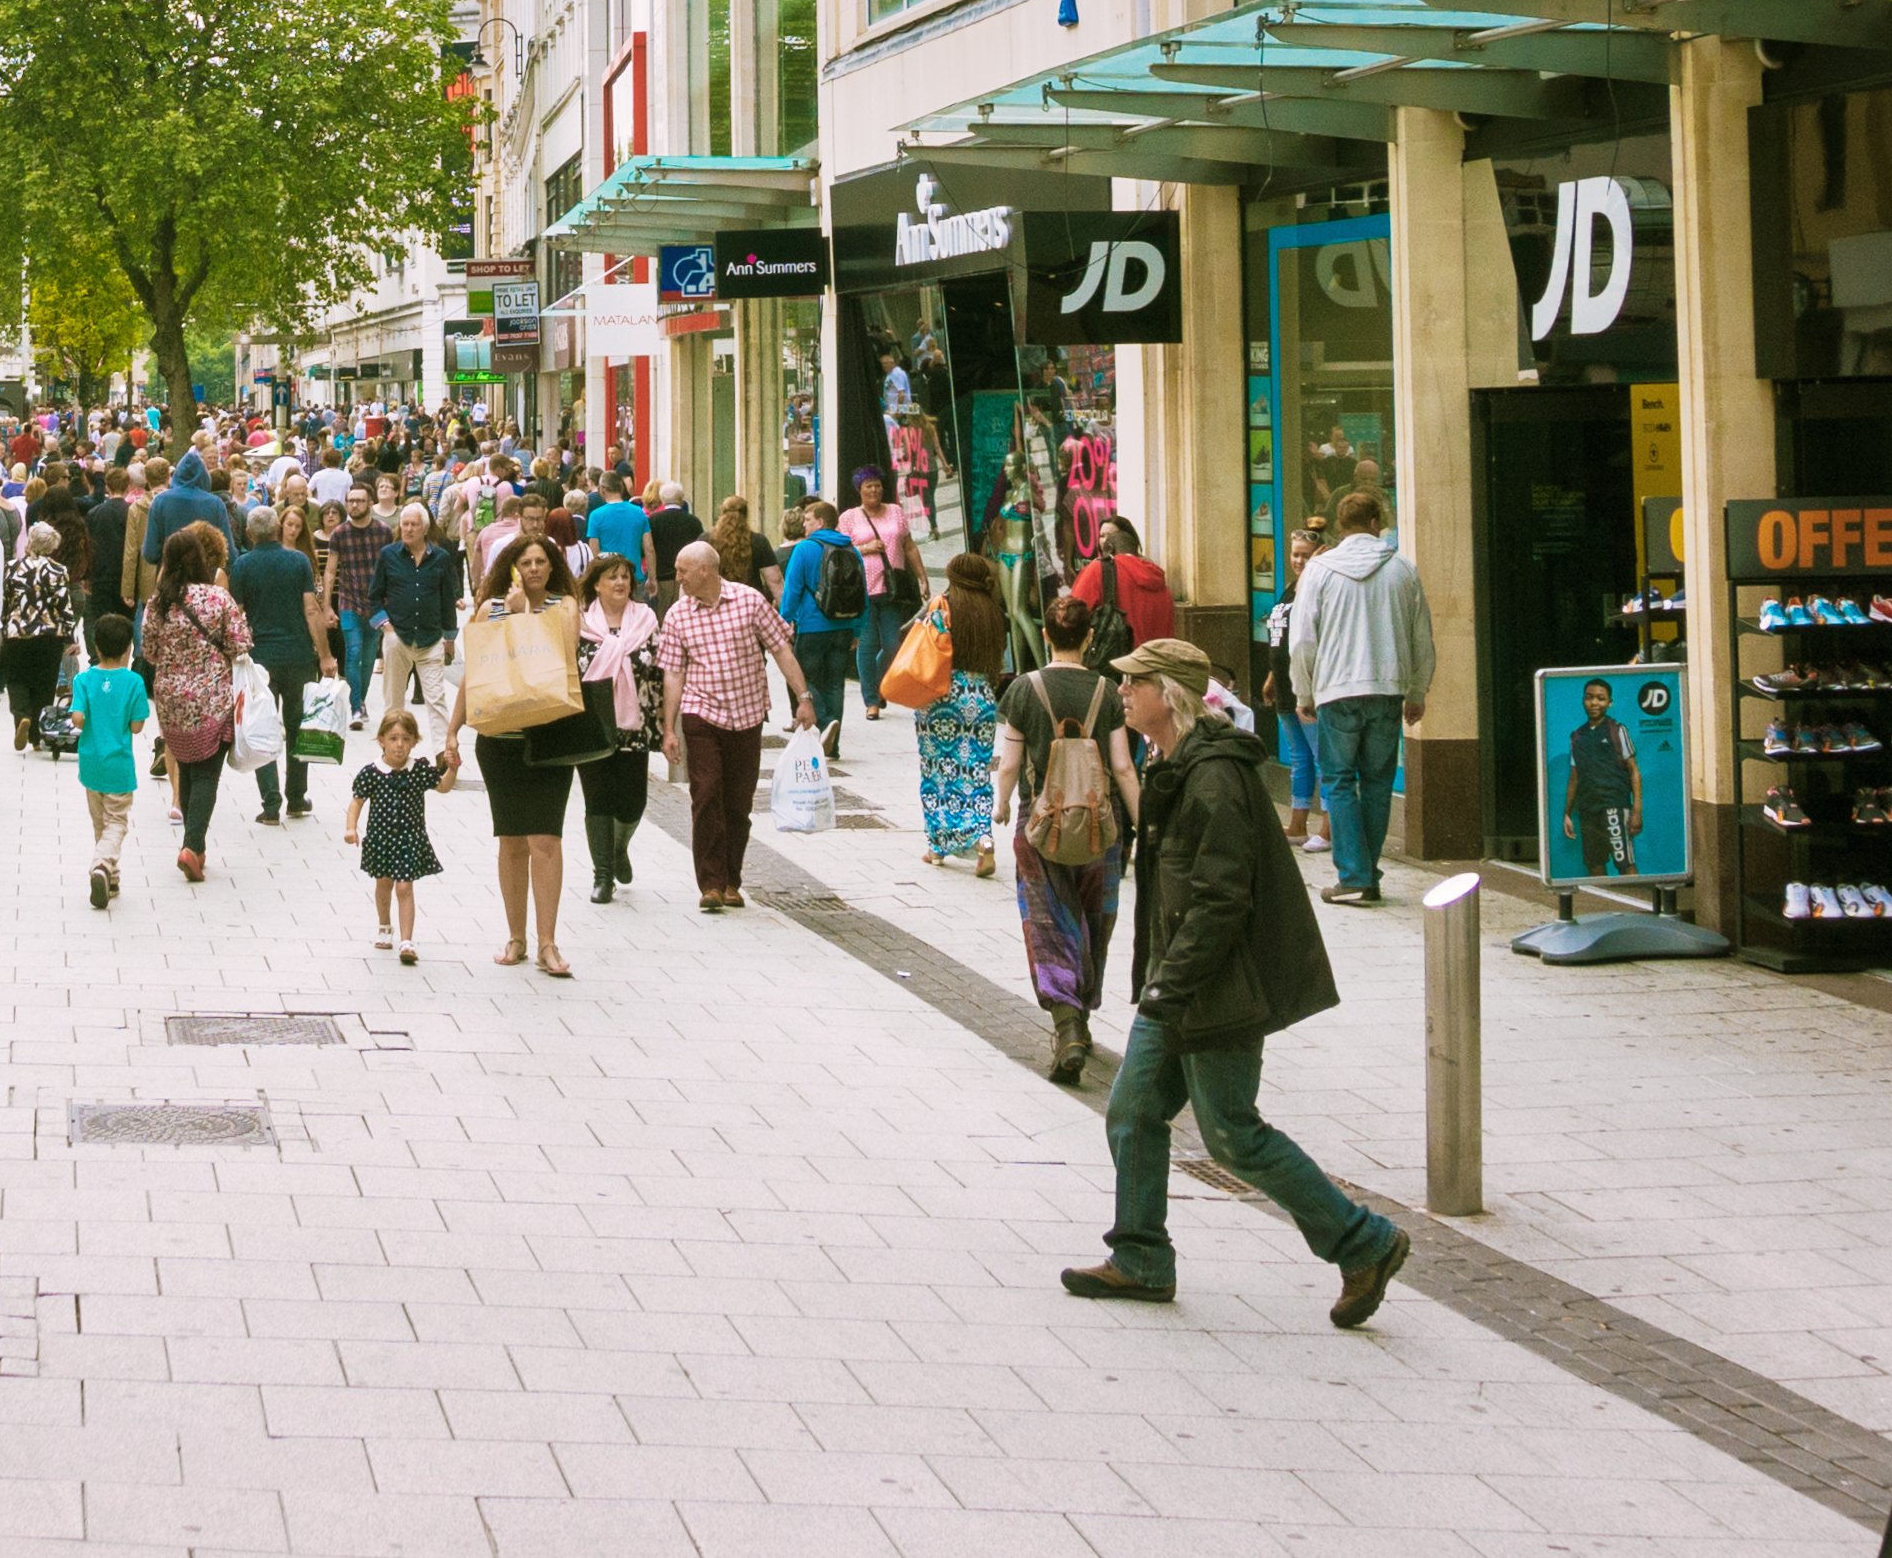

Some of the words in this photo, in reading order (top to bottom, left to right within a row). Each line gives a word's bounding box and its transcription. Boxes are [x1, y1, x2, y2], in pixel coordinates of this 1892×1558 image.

[896, 212, 931, 266] Ann
[928, 203, 1012, 261] Summers
[1532, 175, 1632, 342] JD
[470, 264, 496, 274] SHOP
[498, 264, 511, 273] TO
[513, 264, 531, 273] LET
[726, 262, 753, 276] Ann
[756, 260, 817, 274] Summers
[1060, 242, 1165, 315] JD
[496, 295, 512, 308] TO
[515, 293, 536, 306] LET
[593, 314, 658, 326] MATALAN
[494, 353, 531, 362] Evans
[1641, 689, 1668, 708] JD
[1606, 807, 1626, 863] adidas
